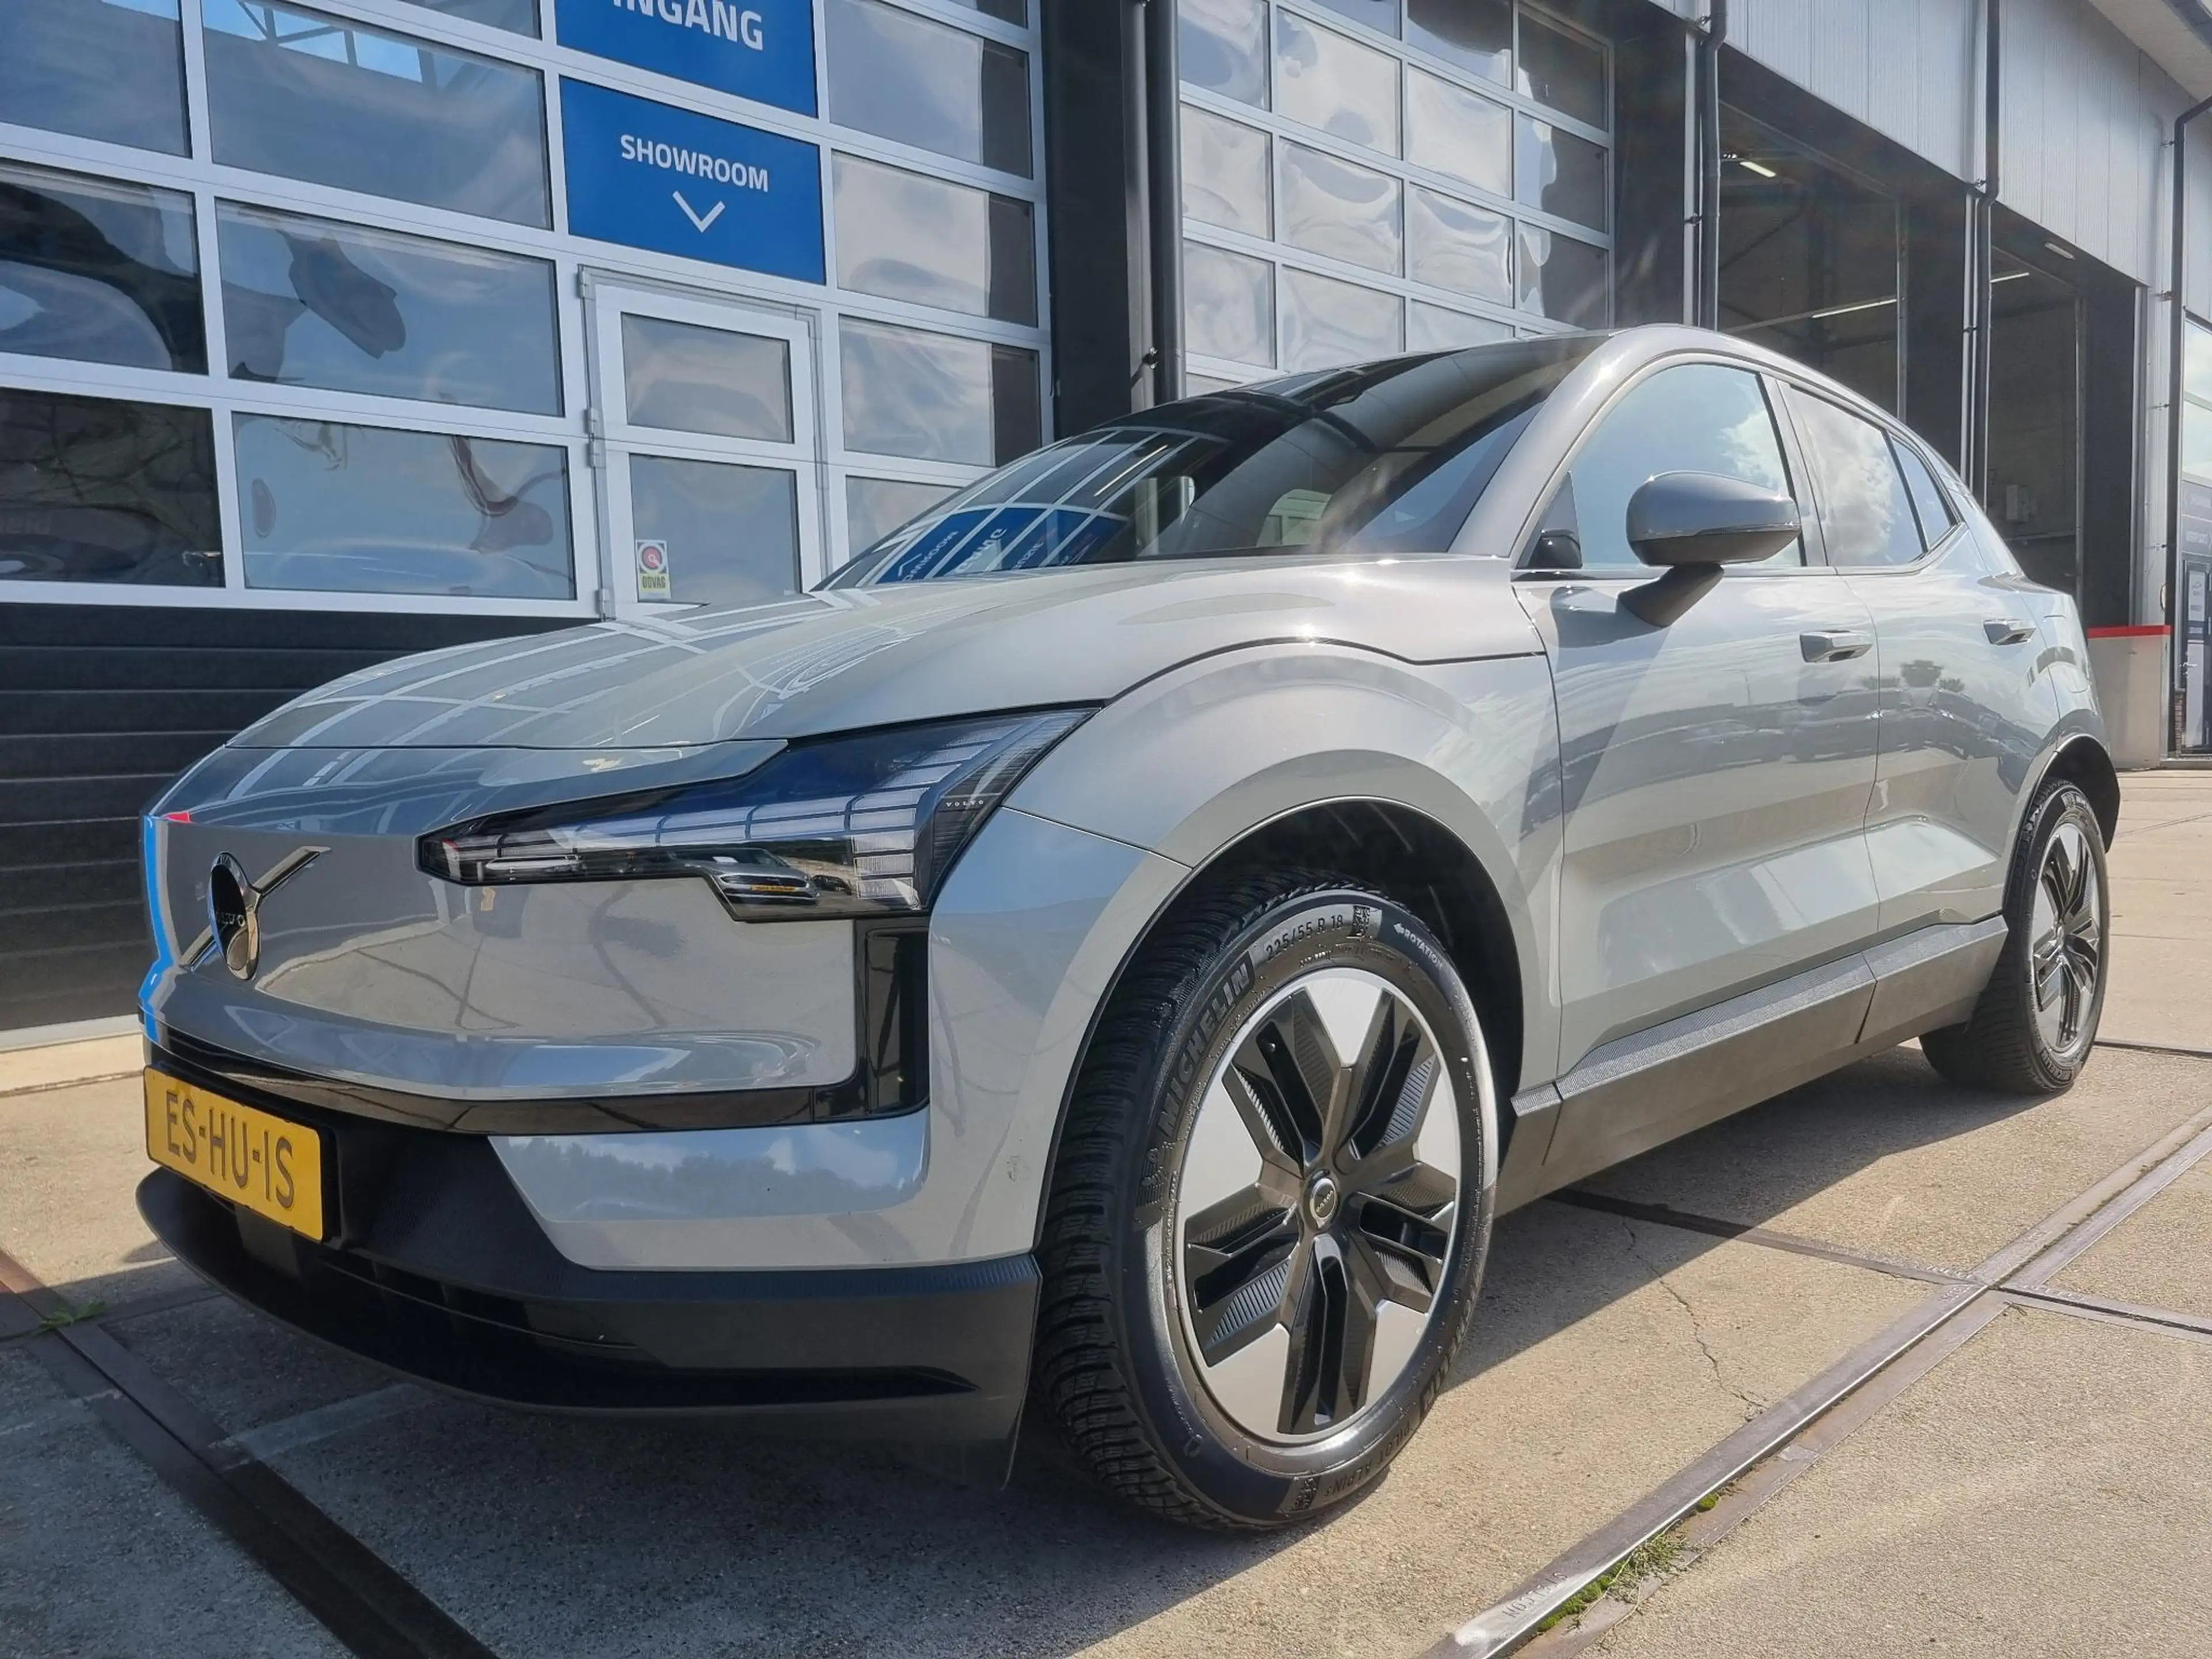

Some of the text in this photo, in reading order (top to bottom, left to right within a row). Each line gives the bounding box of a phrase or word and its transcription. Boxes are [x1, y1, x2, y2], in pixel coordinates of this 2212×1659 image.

[620, 134, 768, 192] SHOWROOM
[1331, 914, 1344, 931] 18
[1157, 962, 1253, 1137] MICHELIN
[166, 1089, 294, 1210] ES-HU-IS
